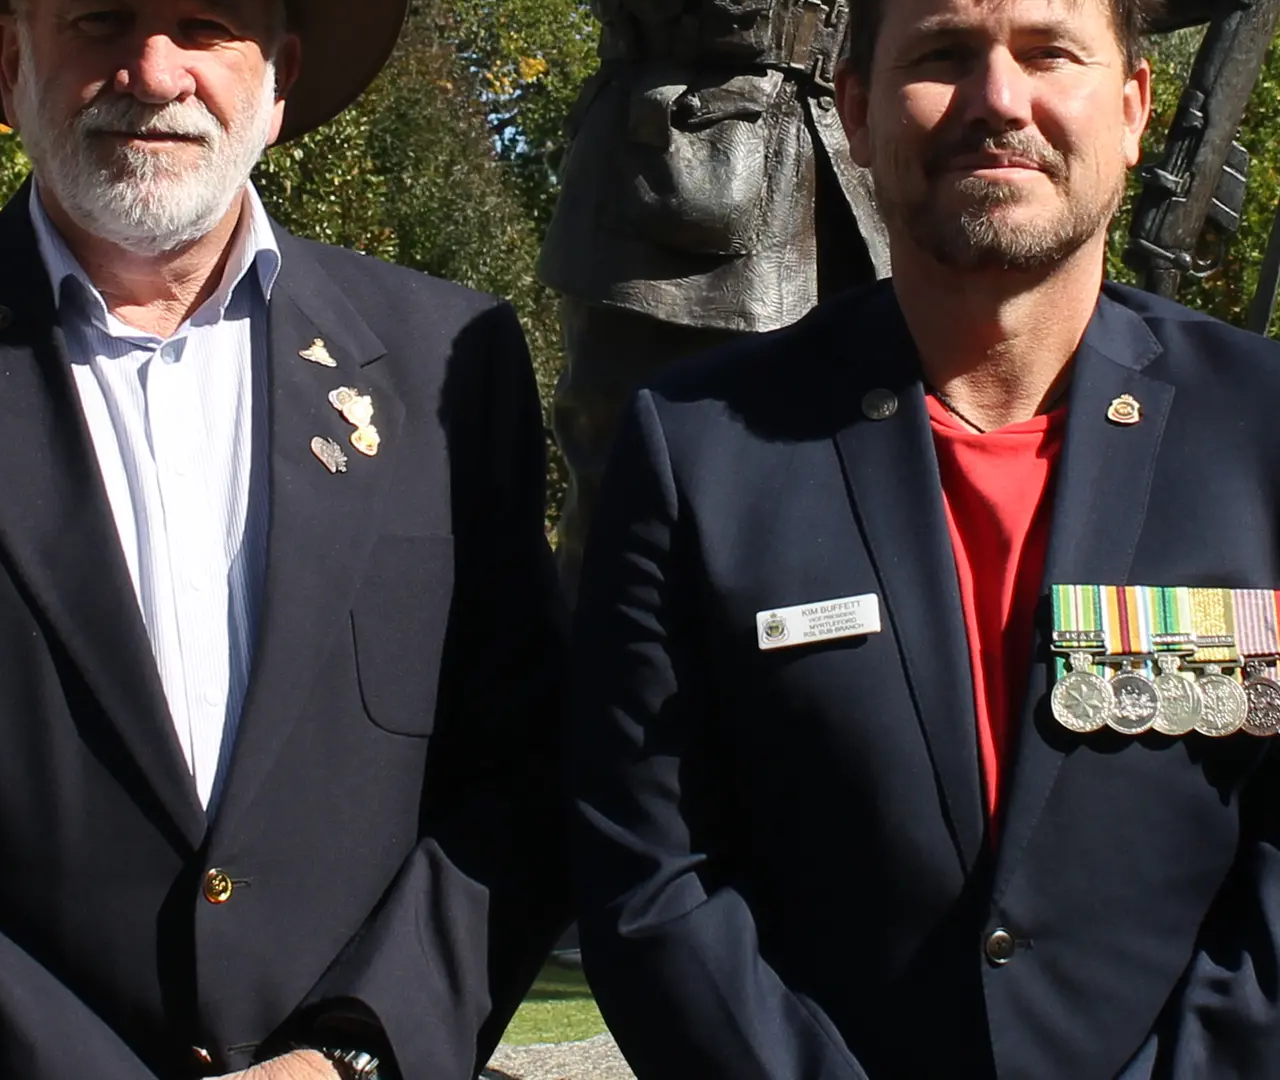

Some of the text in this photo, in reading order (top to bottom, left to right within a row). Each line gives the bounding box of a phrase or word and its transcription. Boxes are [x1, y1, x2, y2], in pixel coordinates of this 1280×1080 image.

[801, 601, 860, 616] KIM BUFFETT
[809, 617, 857, 629] MYRTLEFORD
